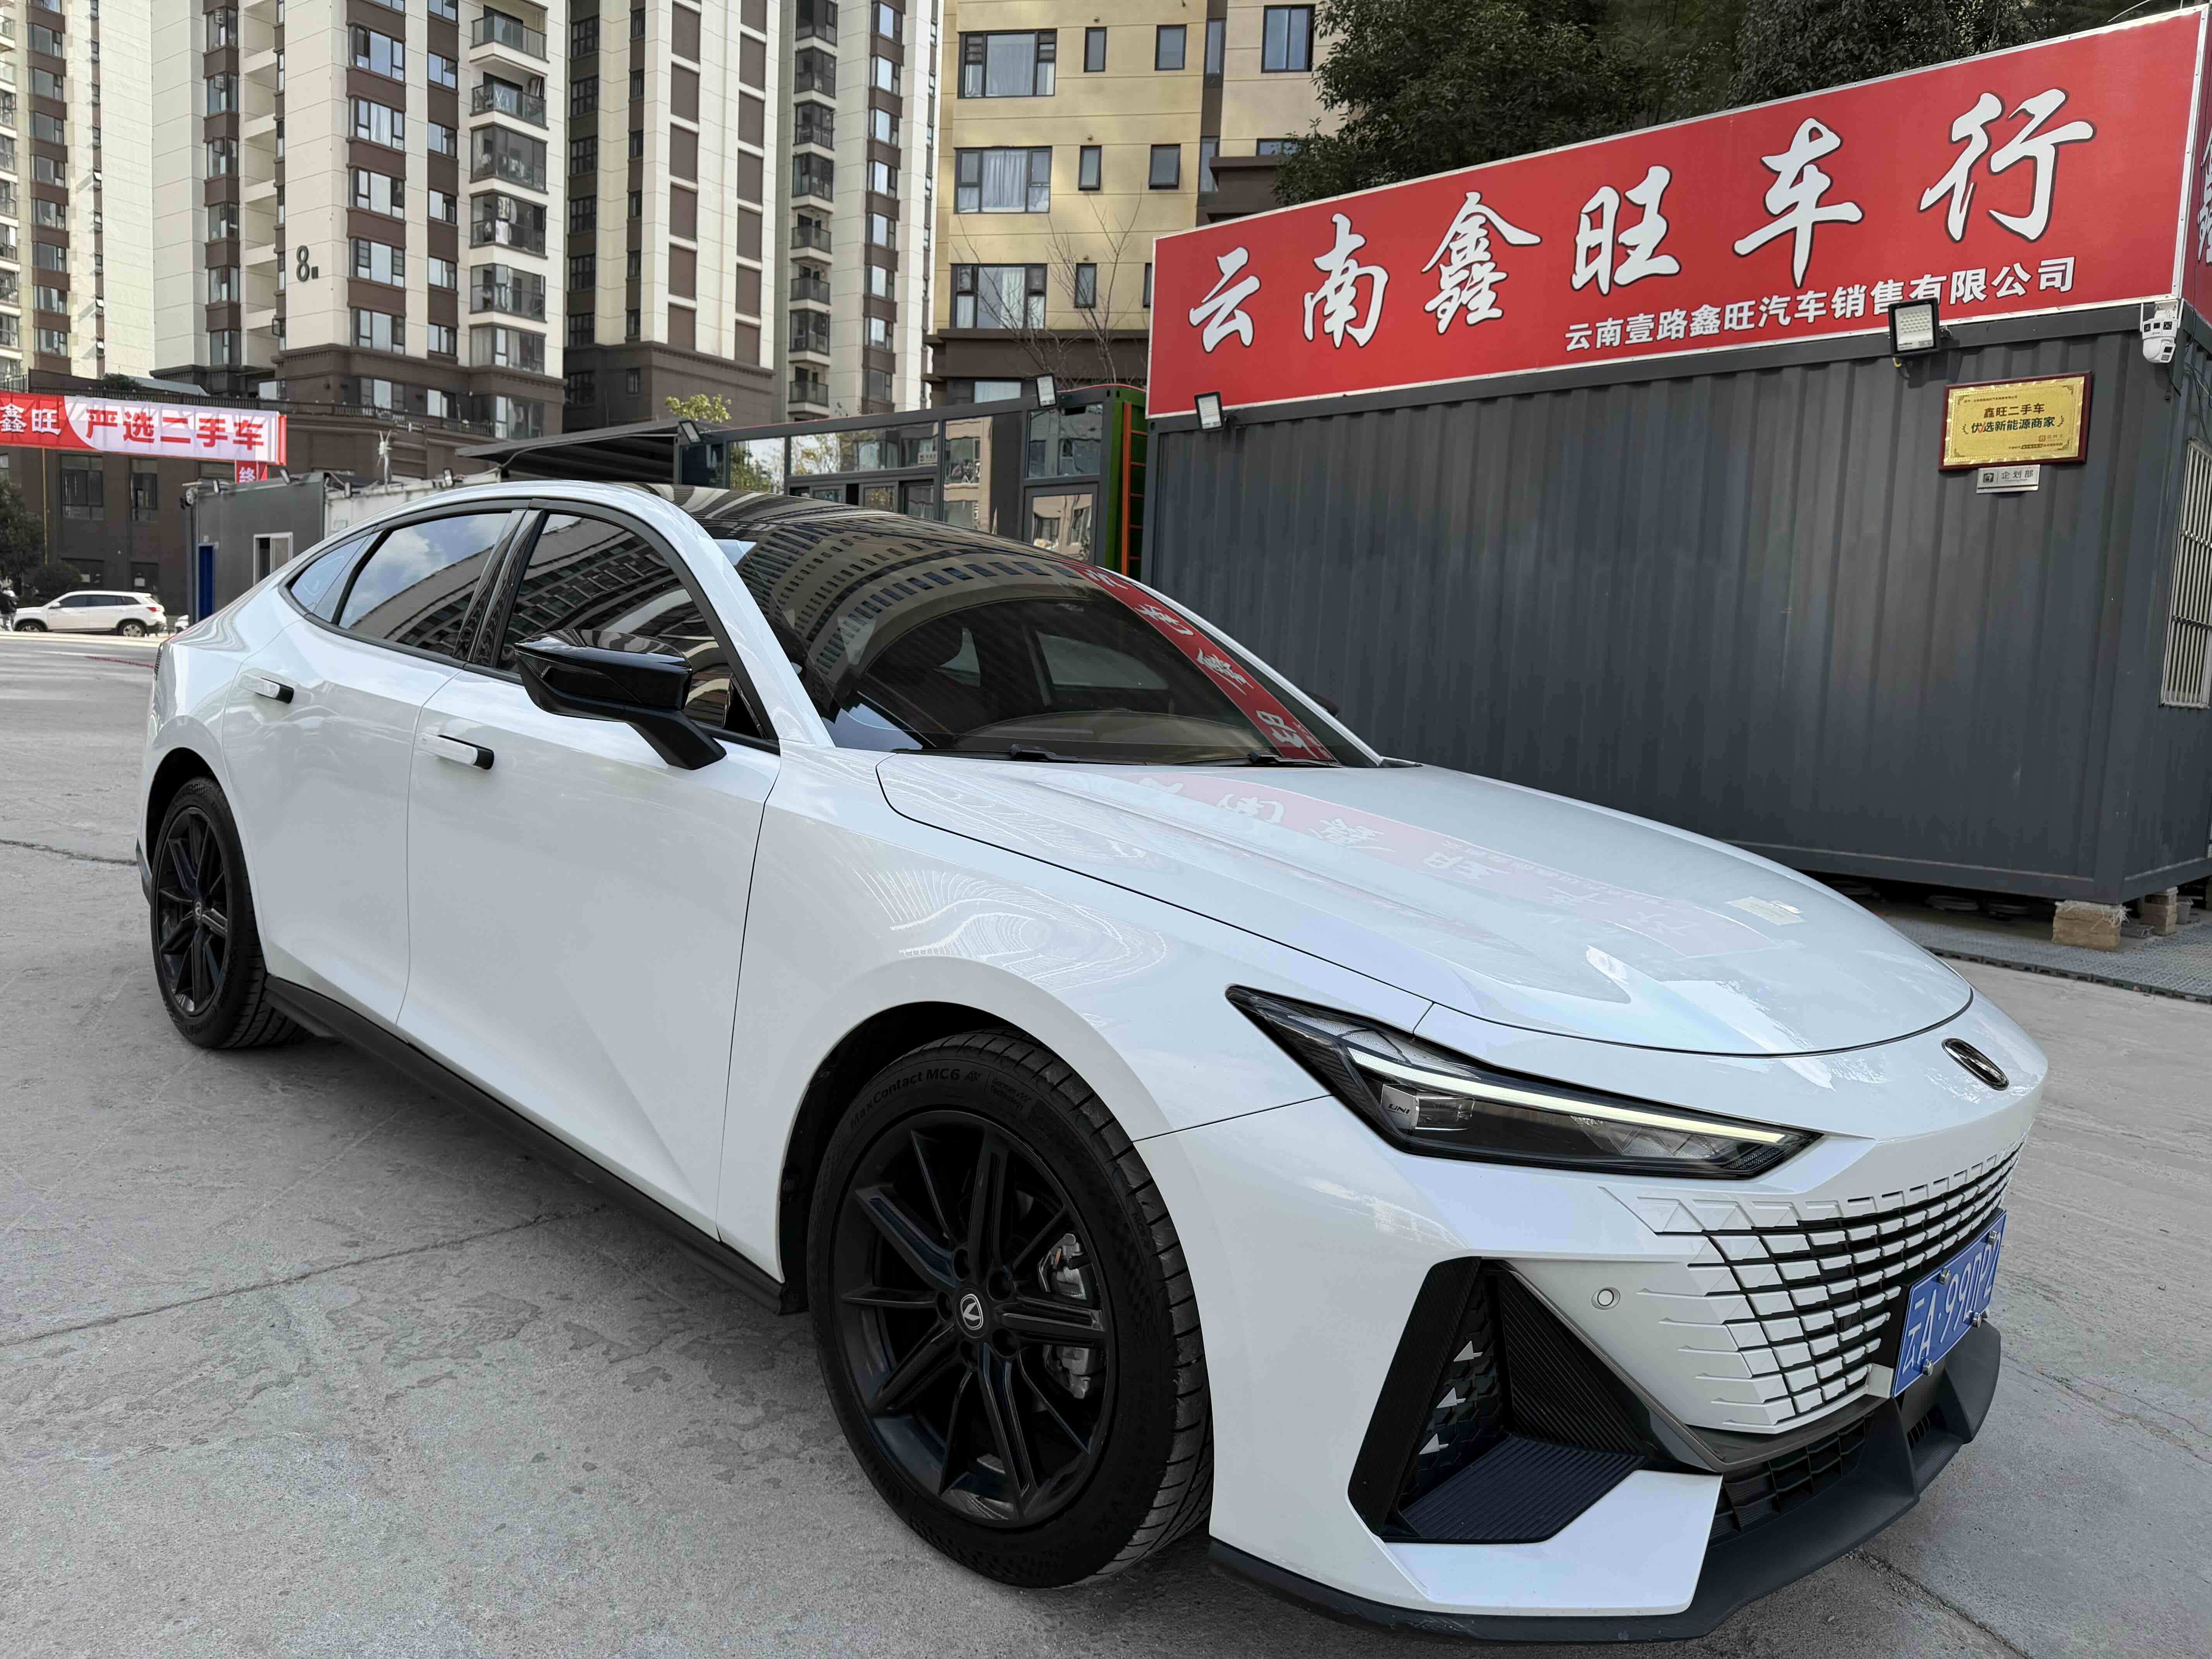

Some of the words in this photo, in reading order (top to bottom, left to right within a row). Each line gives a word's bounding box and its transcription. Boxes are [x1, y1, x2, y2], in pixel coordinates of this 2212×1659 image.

[1189, 88, 2094, 353] 云南鑫旺车行
[1565, 256, 2075, 351] 云南壹路鑫旺汽车销售有限公司
[1984, 403, 2045, 418] 鑫旺二手车
[0, 403, 62, 436] 鑫旺
[86, 408, 264, 450] 严选二手车
[1971, 416, 2055, 433] 优选新能源商家
[2002, 470, 2033, 479] 企划部
[926, 1068, 960, 1080] MC6
[1388, 1104, 1410, 1115] UNI
